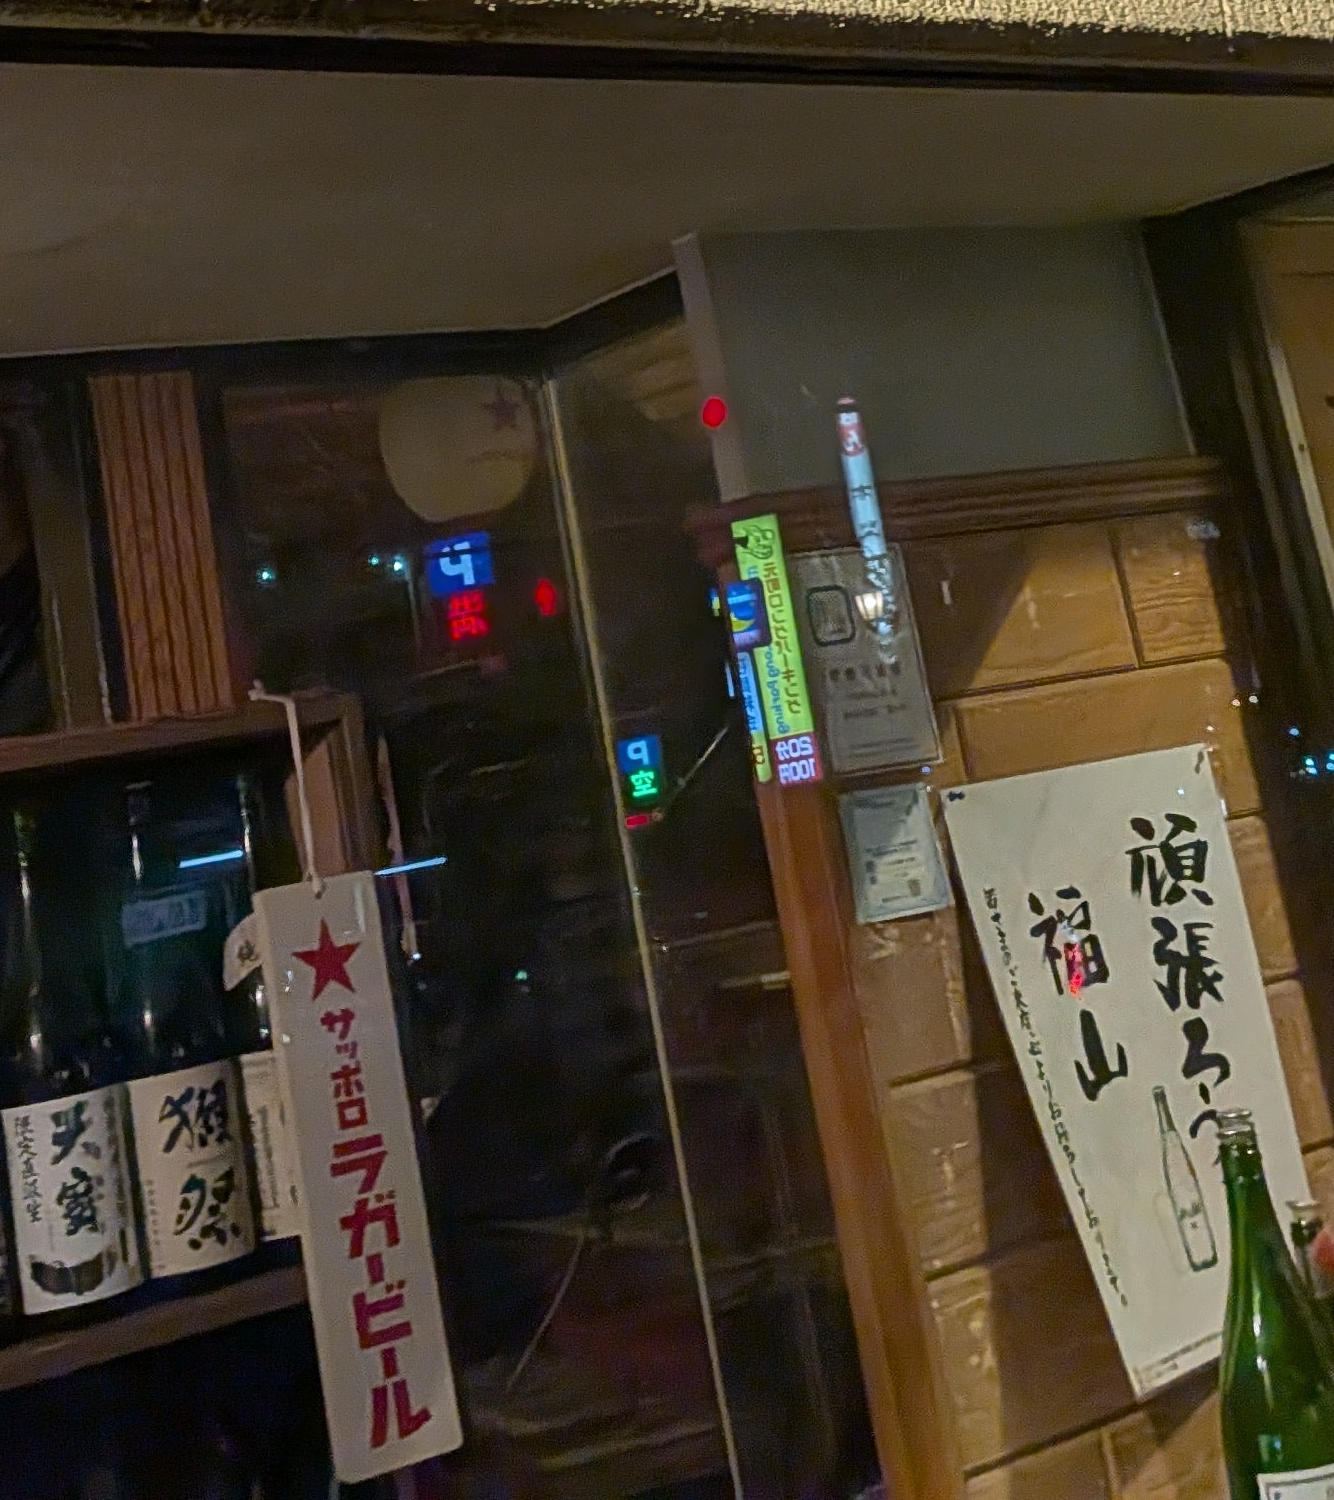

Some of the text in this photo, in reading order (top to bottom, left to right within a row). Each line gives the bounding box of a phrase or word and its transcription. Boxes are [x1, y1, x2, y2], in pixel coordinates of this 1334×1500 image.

[1028, 886, 1128, 1101] 福山
[319, 1006, 433, 1449] サッポロラガービール
